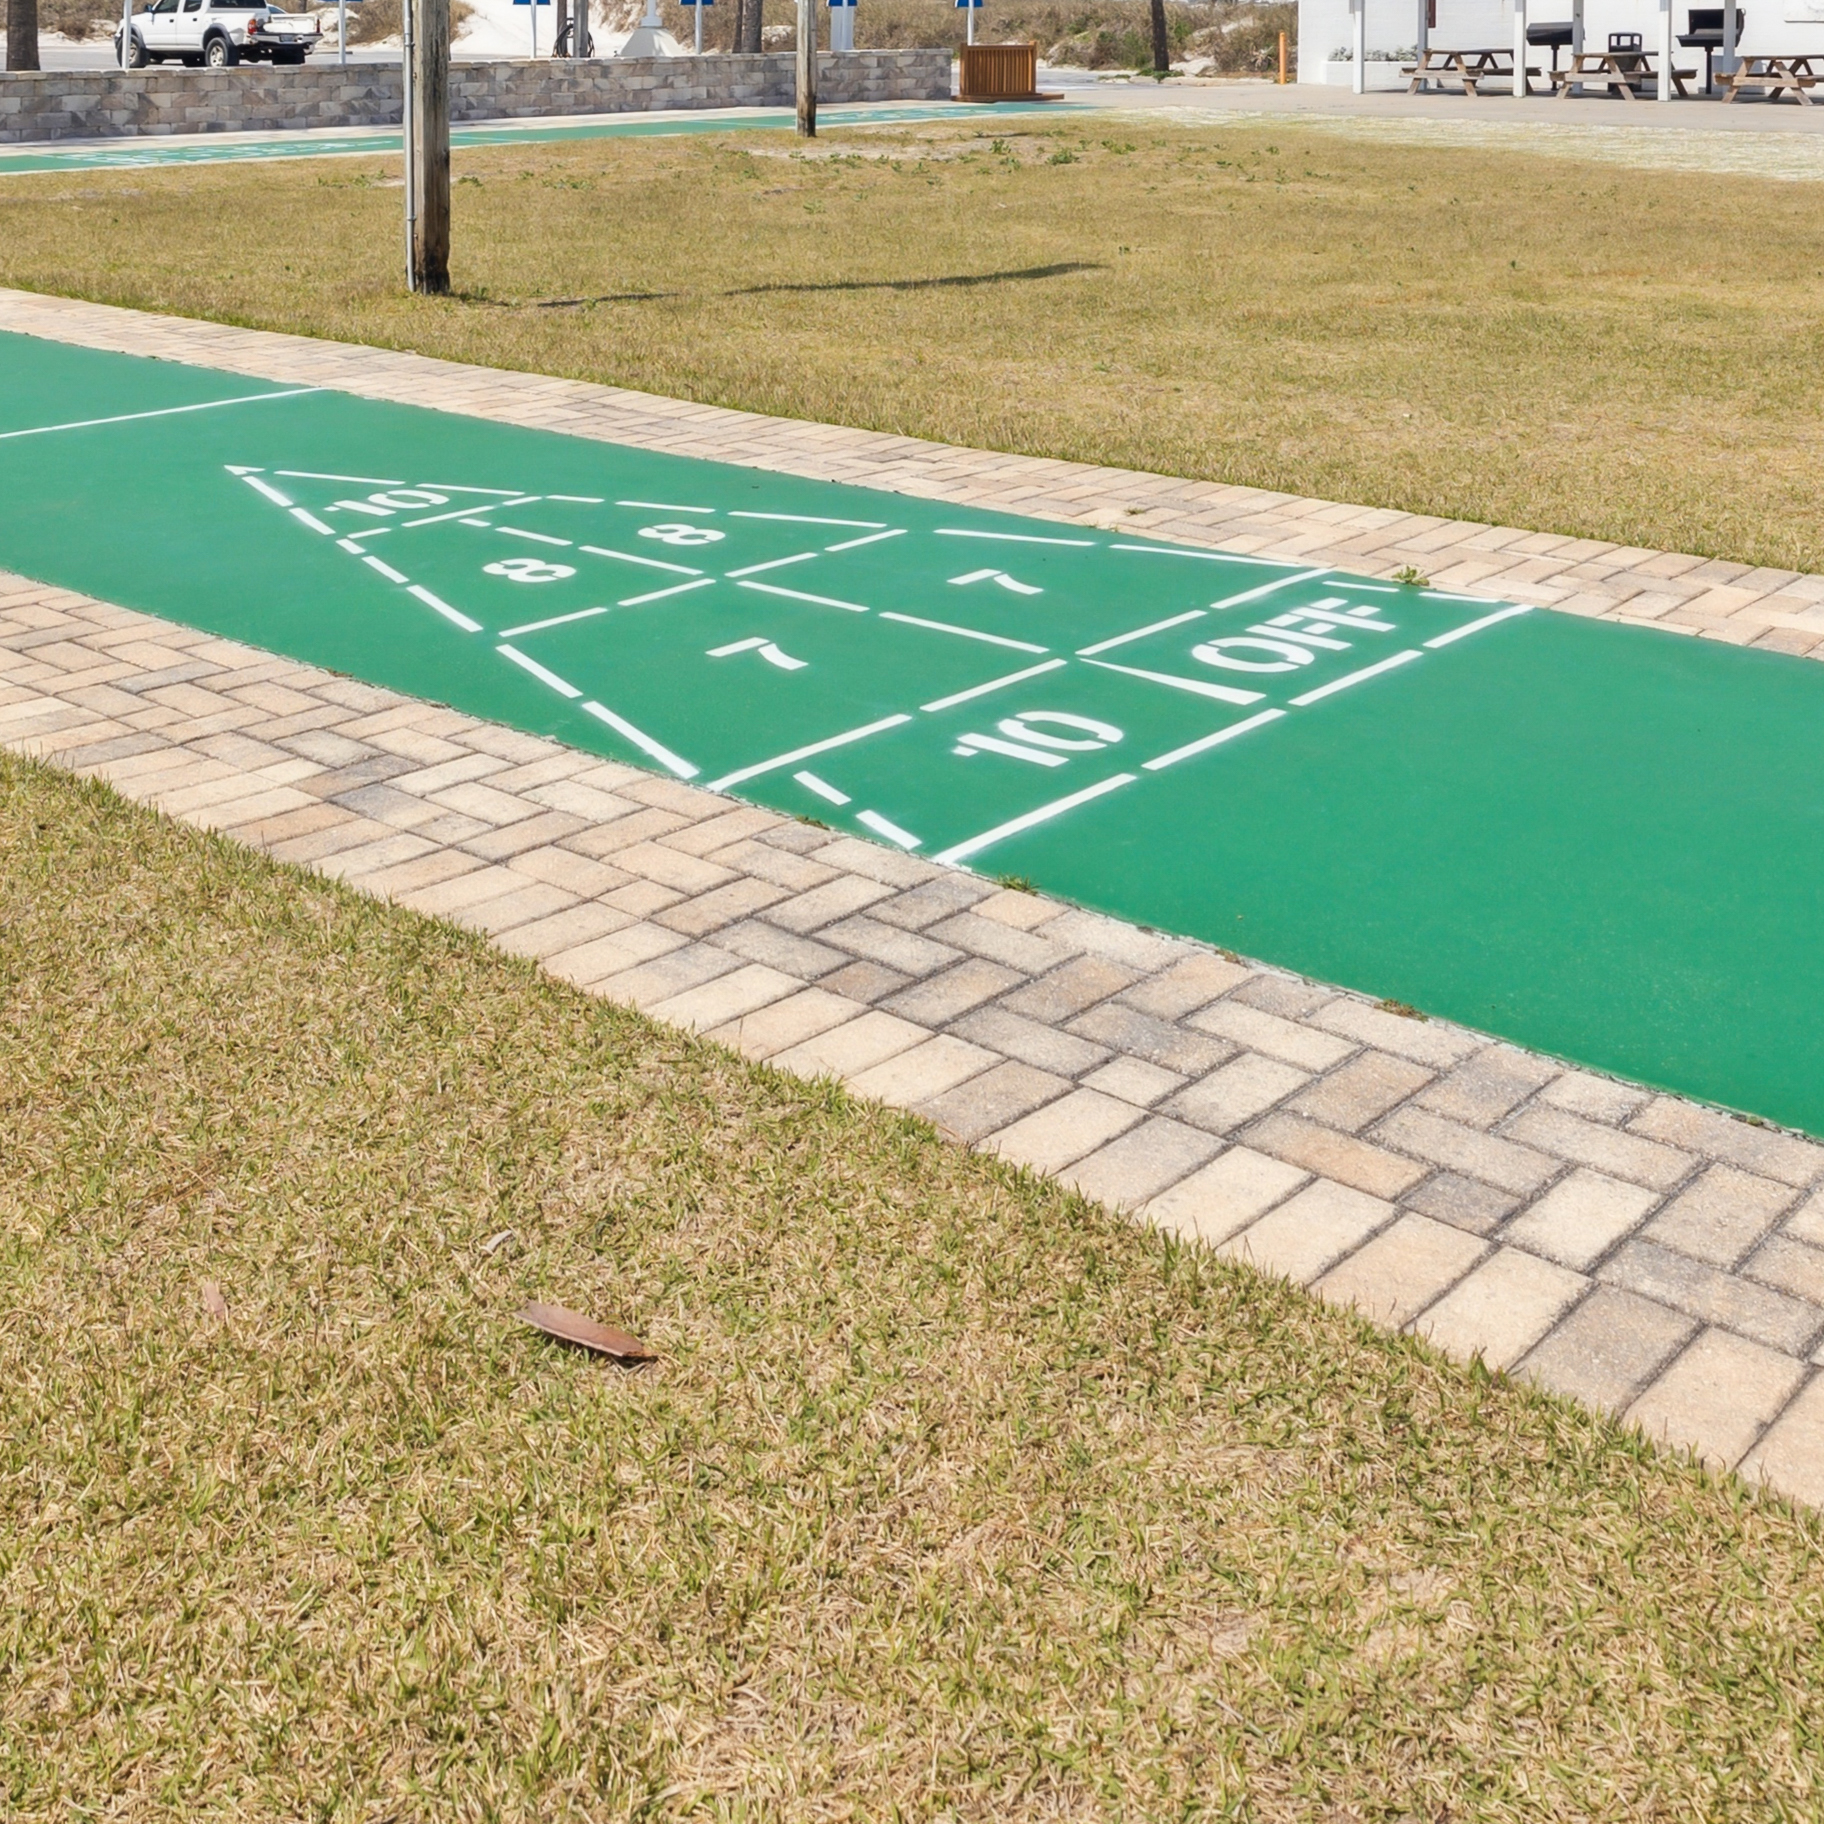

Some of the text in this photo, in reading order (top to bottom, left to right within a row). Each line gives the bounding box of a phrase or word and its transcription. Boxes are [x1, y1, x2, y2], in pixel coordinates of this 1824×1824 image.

[323, 488, 451, 517] 10
[637, 523, 727, 546] 8
[481, 557, 578, 584] 8
[947, 568, 1044, 596] 7
[705, 636, 809, 671] 7
[952, 596, 1397, 768] 10 OFF
